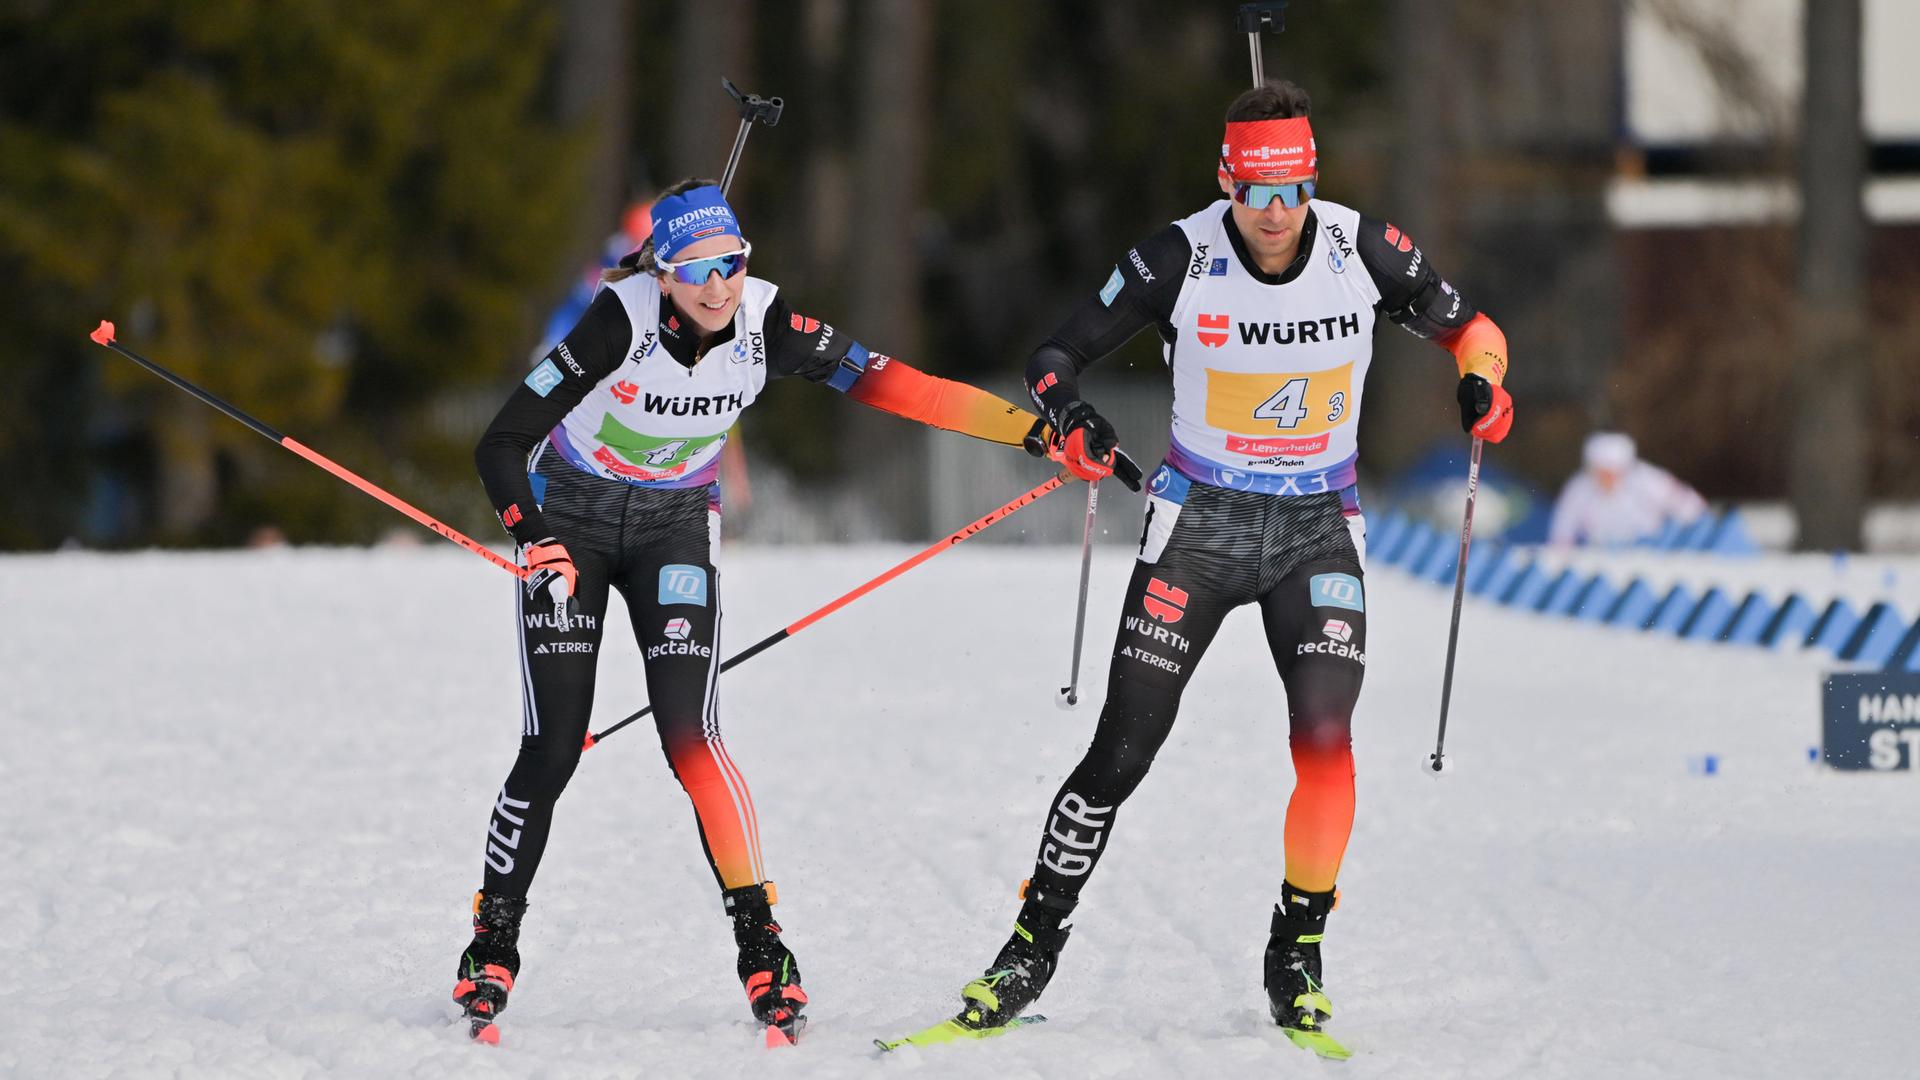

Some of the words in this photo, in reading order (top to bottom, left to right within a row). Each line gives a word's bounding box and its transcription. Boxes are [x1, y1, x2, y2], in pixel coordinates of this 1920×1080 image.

[1243, 158, 1303, 169] Wärmepumpen
[667, 206, 732, 232] ERDINGER
[671, 217, 734, 241] ALKOHOLFREI
[1325, 223, 1353, 259] JOKA
[1129, 248, 1156, 284] TERREX
[1189, 243, 1209, 280] JOKA
[659, 321, 680, 340] WÜRTH
[1238, 312, 1360, 345] WÜRTH
[559, 345, 586, 378] TERREX
[630, 329, 655, 365] JOKA
[749, 331, 764, 366] JOKA
[644, 391, 743, 417] WÜRTH
[1253, 377, 1309, 429] 4
[1326, 391, 1346, 423] 3
[1252, 441, 1322, 454] Lenzerheide
[550, 642, 593, 653] TERREX
[648, 640, 711, 660] tectake
[1126, 615, 1190, 654] WÜRTH
[1135, 648, 1182, 676] TERREX
[1297, 639, 1366, 666] tectake
[483, 784, 530, 875] GER
[1043, 791, 1113, 877] GER
